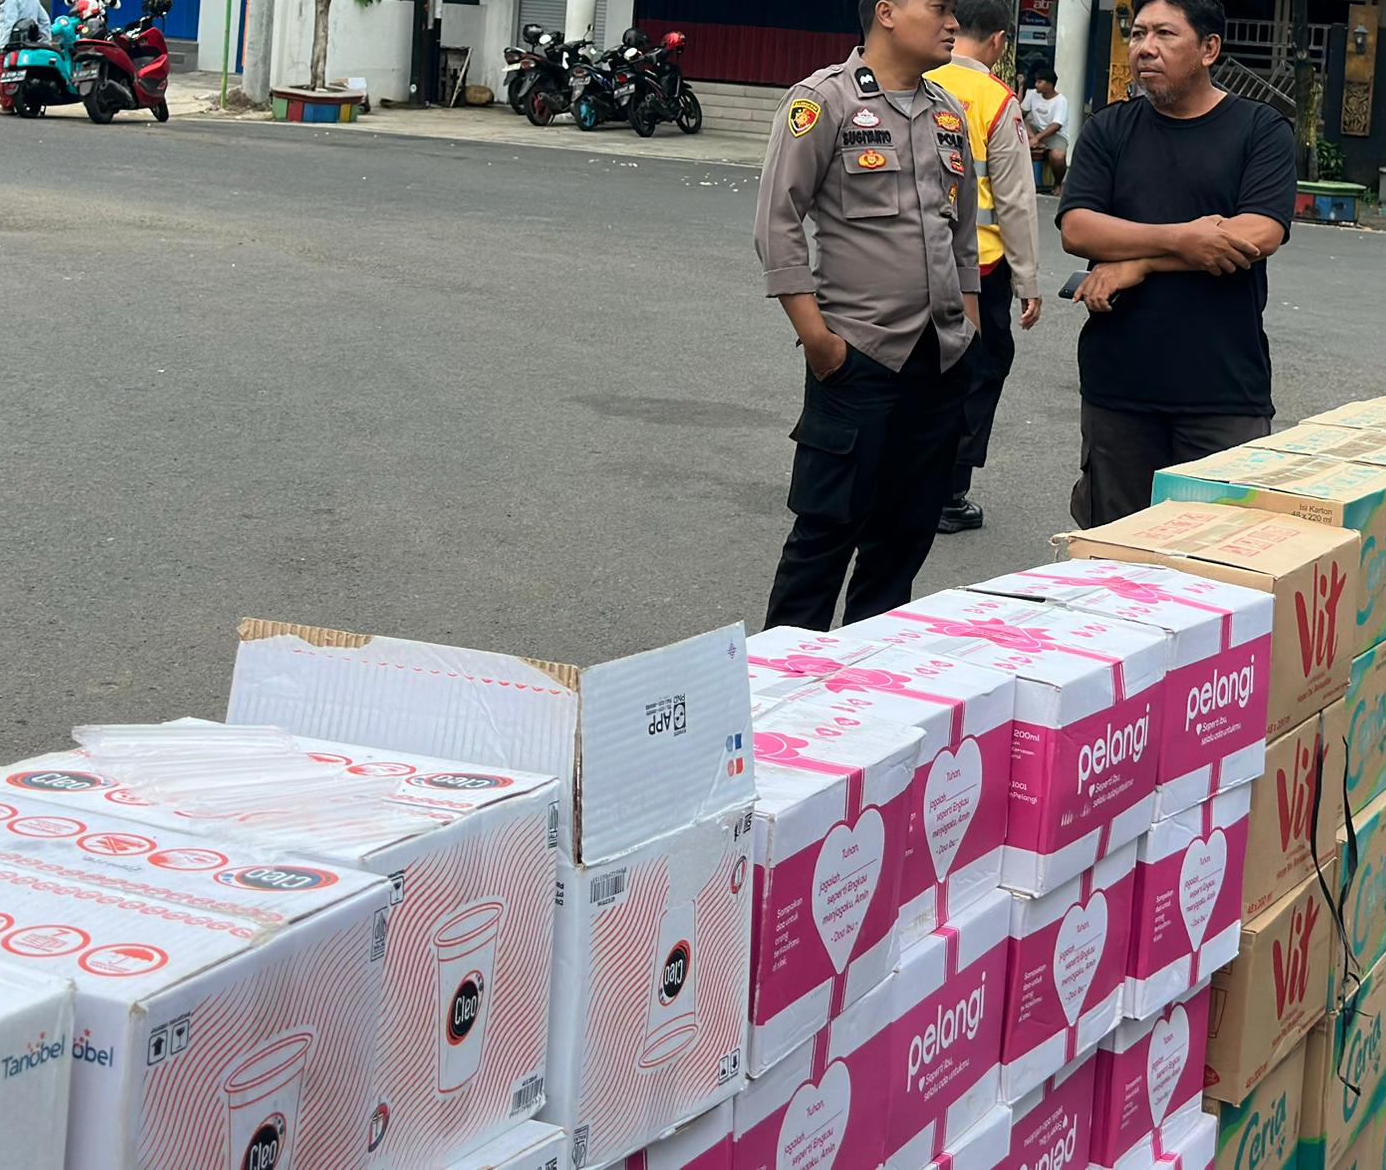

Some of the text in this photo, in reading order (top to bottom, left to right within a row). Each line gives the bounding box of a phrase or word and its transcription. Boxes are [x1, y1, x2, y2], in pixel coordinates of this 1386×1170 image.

[1309, 505, 1332, 515] Karton
[1294, 560, 1347, 678] Vit
[1185, 654, 1255, 731] pelangi
[1014, 729, 1040, 742] 200ml
[1077, 703, 1150, 795] pelangi
[32, 773, 90, 790] Cleo
[433, 774, 491, 789] Cleo
[245, 868, 311, 888] Cleo
[664, 958, 683, 984] Cleo
[1272, 894, 1321, 1021] Vit
[454, 994, 477, 1026] Cleo
[907, 971, 986, 1092] pelangi
[2, 1034, 65, 1079] Tanobel
[72, 1039, 113, 1067] obel
[1234, 1091, 1286, 1170] Ceria
[249, 1140, 278, 1170] Cleo
